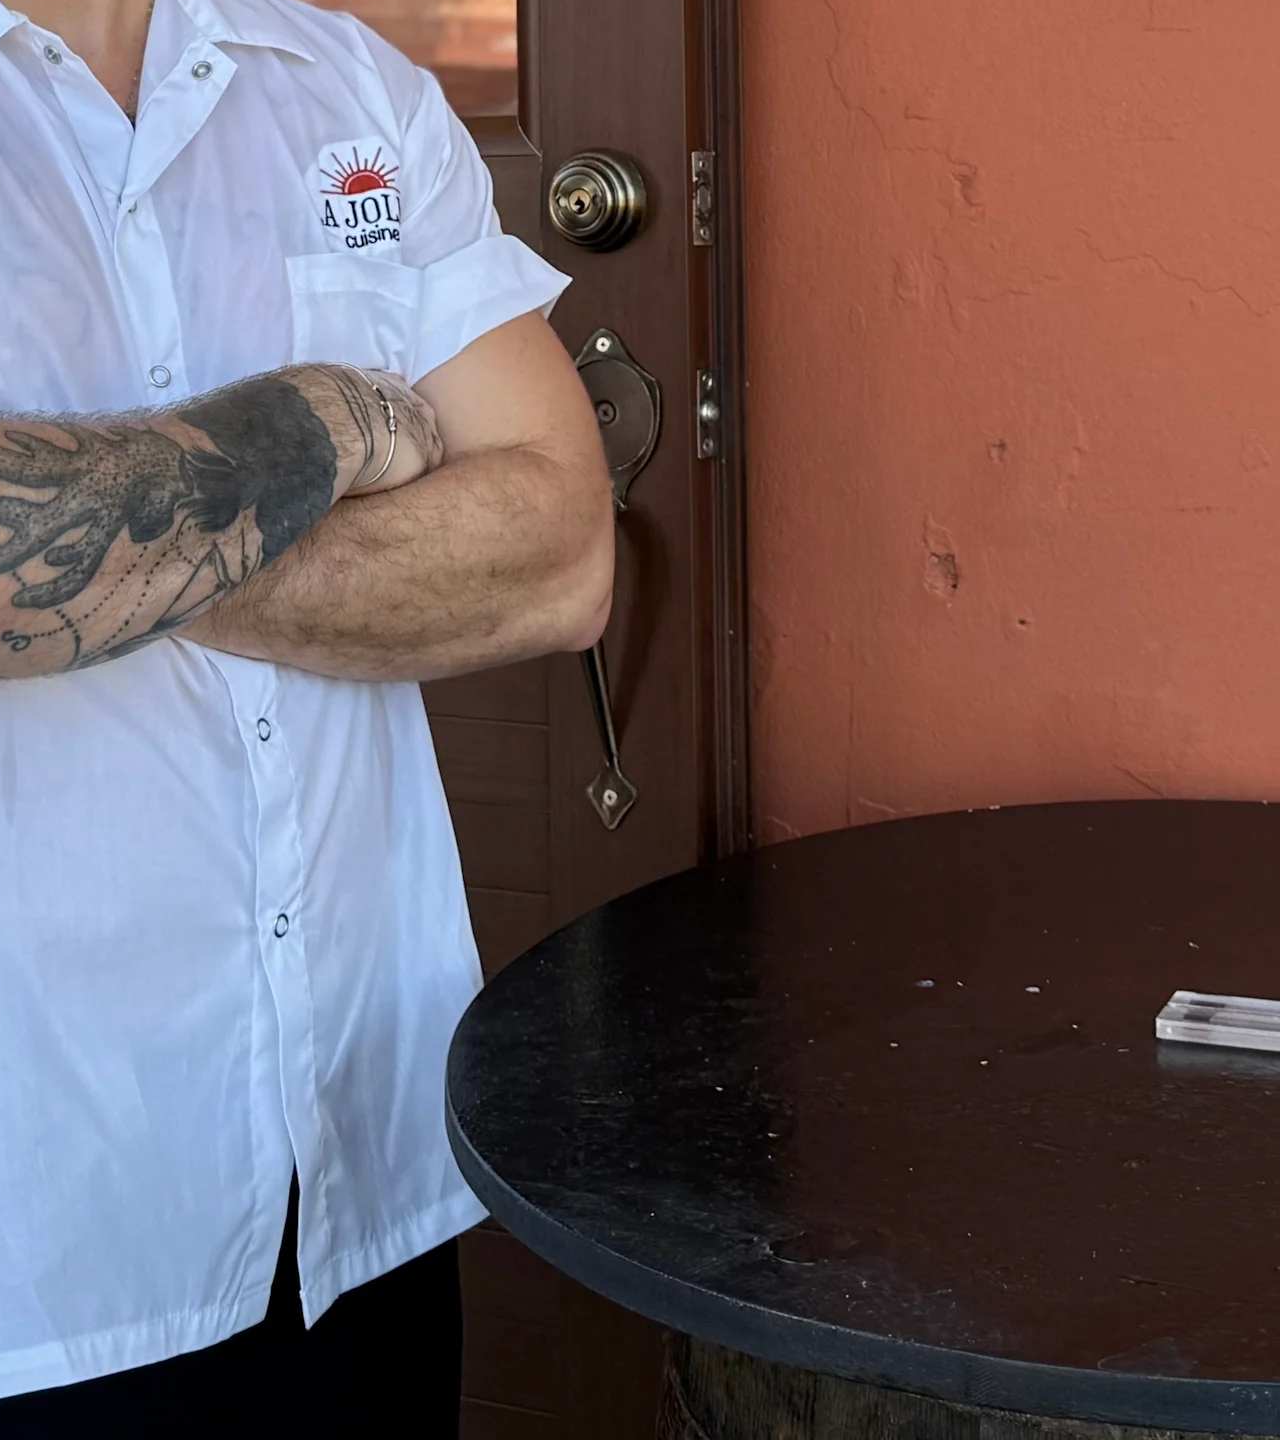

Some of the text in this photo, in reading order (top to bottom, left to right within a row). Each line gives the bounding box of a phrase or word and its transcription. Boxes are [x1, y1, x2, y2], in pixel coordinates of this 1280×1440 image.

[320, 193, 402, 229] A JOL
[345, 224, 401, 249] cuisine
